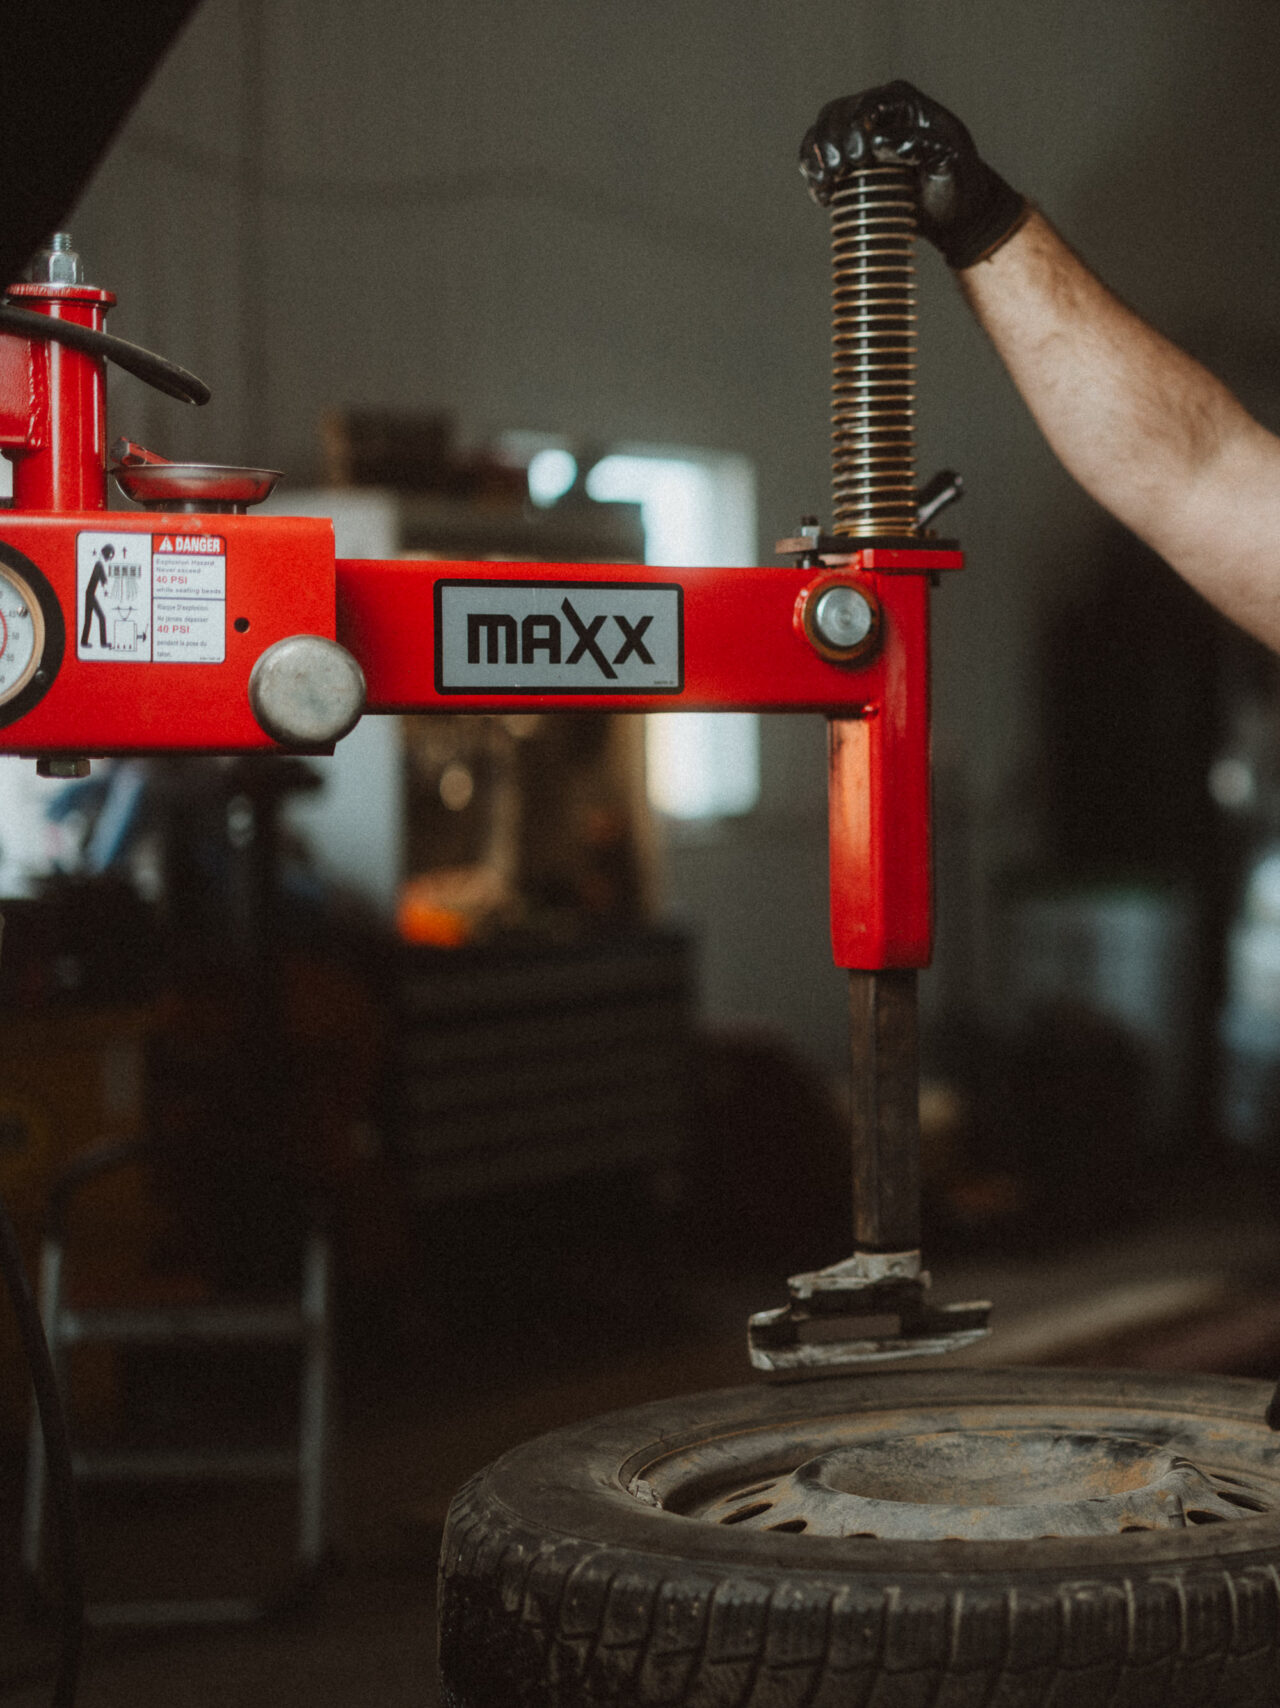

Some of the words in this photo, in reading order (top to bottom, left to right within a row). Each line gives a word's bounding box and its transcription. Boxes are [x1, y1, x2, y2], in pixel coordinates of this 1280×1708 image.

[175, 536, 220, 553] DANGER
[191, 559, 215, 567] Hazard
[156, 575, 168, 584] 40
[170, 575, 188, 585] PSI
[175, 587, 200, 595] seating
[157, 624, 169, 634] 40
[172, 624, 190, 634] PSI
[467, 596, 656, 679] MAXX
